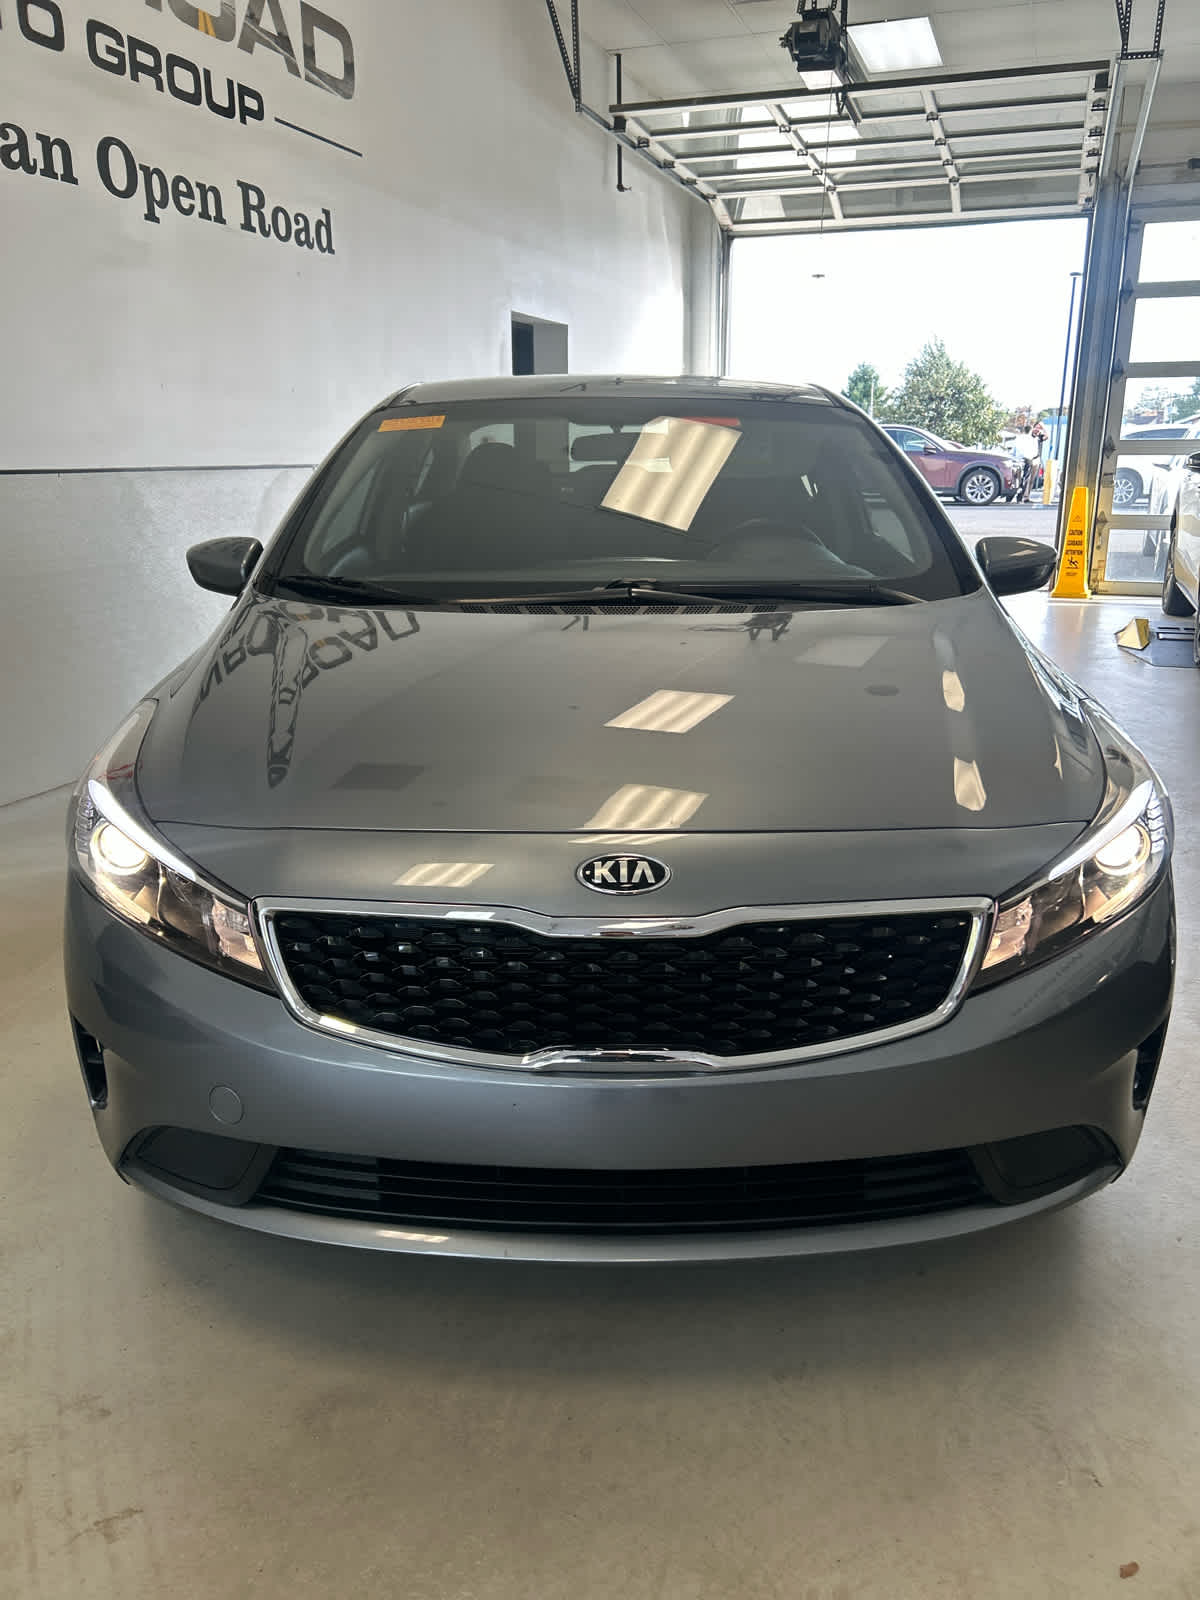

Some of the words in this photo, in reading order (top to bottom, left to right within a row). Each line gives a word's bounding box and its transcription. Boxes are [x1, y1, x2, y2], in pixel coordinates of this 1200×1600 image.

[86, 19, 265, 125] GROUP
[0, 122, 78, 185] an
[96, 136, 226, 224] Open
[236, 179, 335, 255] Road
[591, 860, 656, 884] KIA
